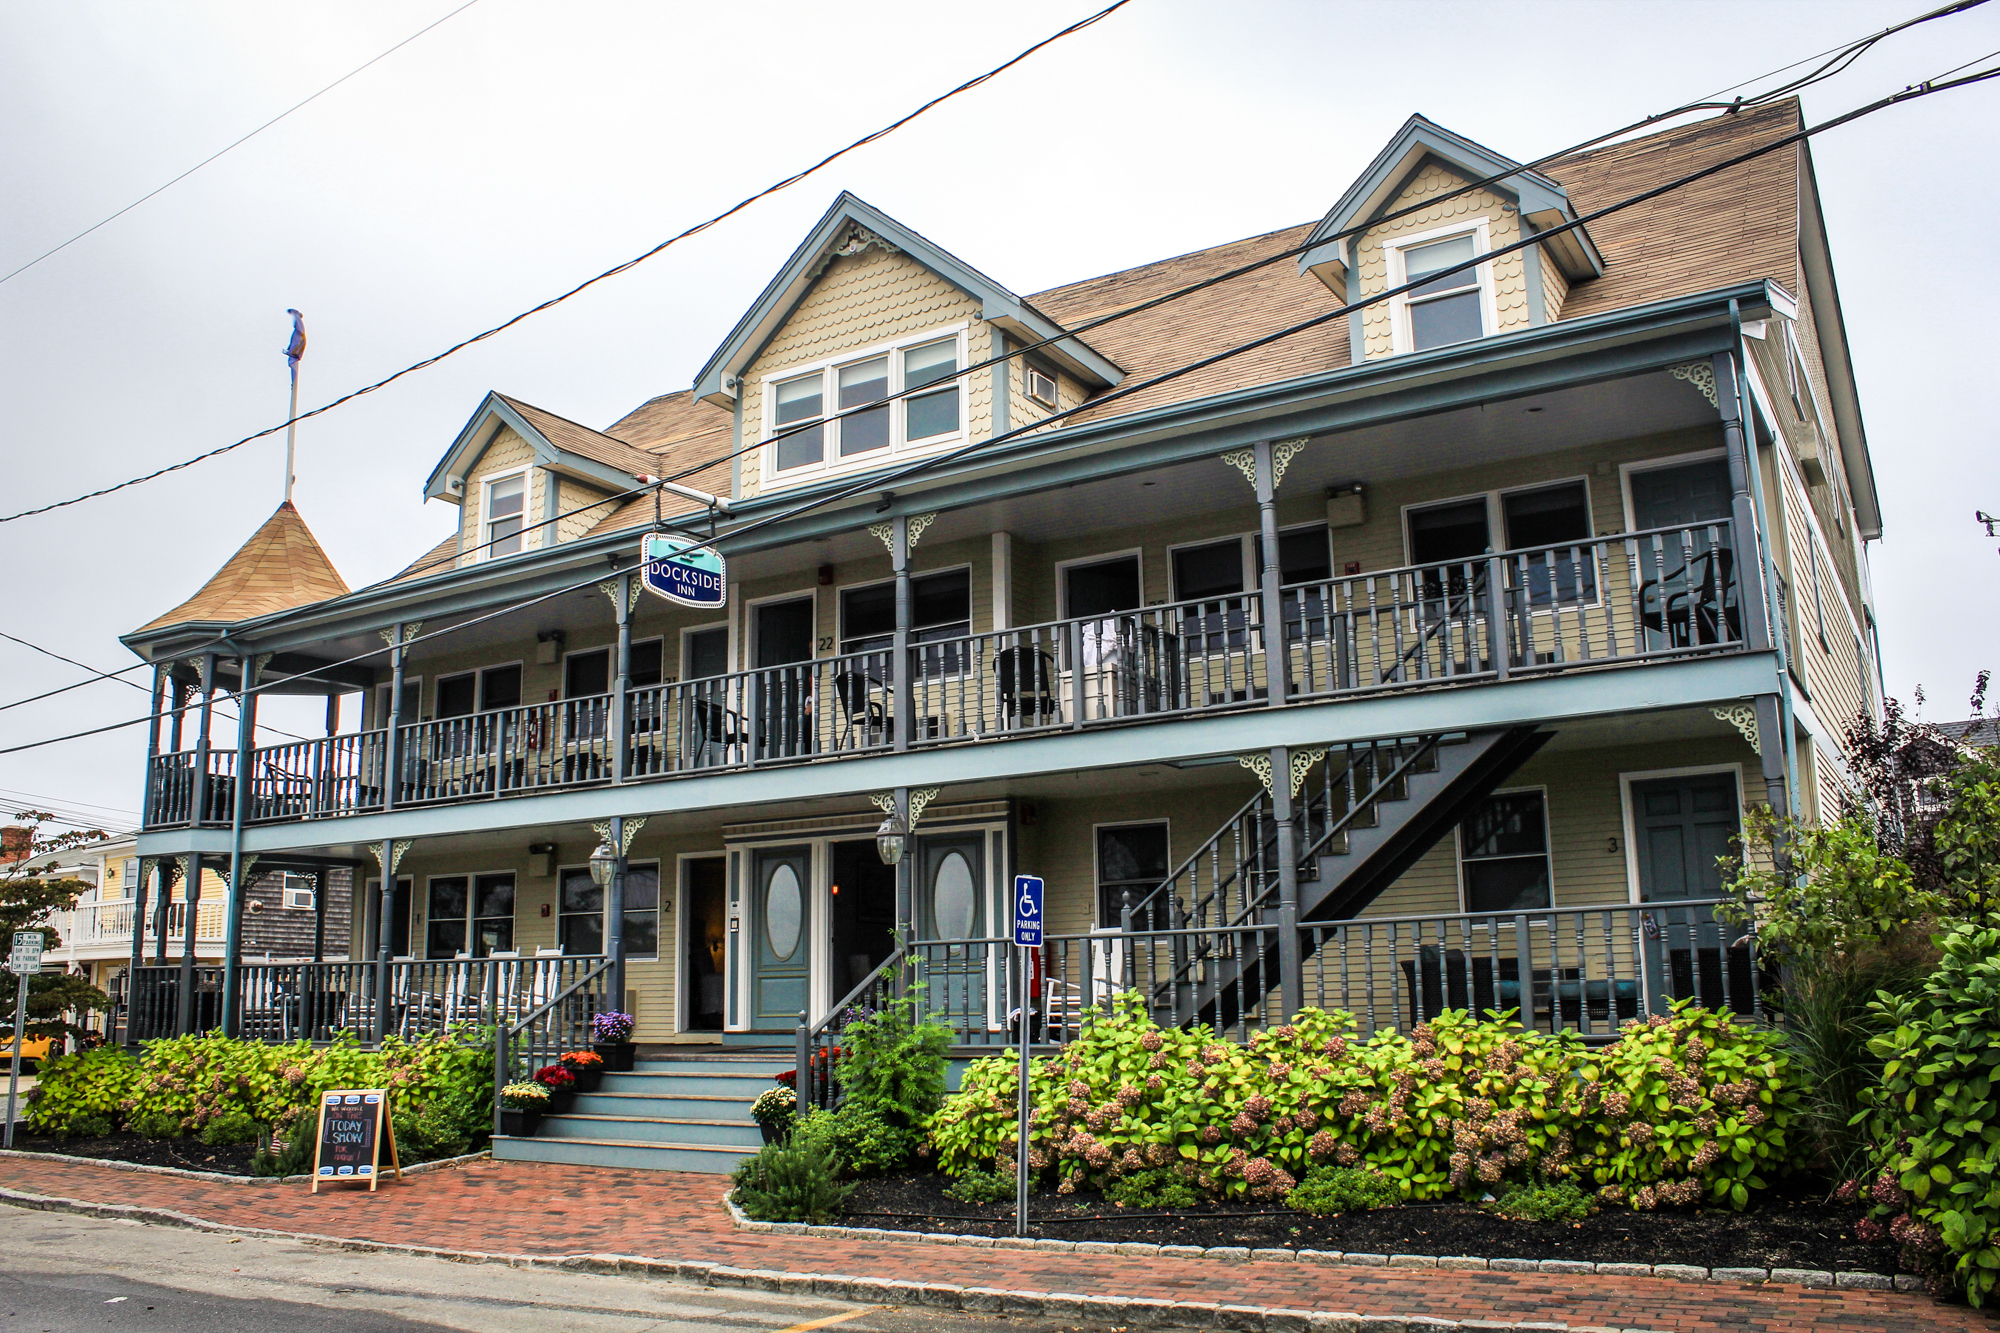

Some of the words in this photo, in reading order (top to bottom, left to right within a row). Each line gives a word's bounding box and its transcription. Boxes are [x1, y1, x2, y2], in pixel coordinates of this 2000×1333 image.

[651, 562, 720, 592] DOCKSIDE
[677, 583, 696, 597] INN
[818, 637, 833, 651] 22
[1608, 837, 1618, 853] 3
[664, 901, 672, 913] 2
[1016, 919, 1041, 931] PARKING
[15, 934, 23, 945] 15
[1021, 931, 1036, 942] ONLY
[347, 1111, 363, 1119] THE
[331, 1119, 363, 1132] TODAY
[332, 1131, 364, 1144] SHOW
